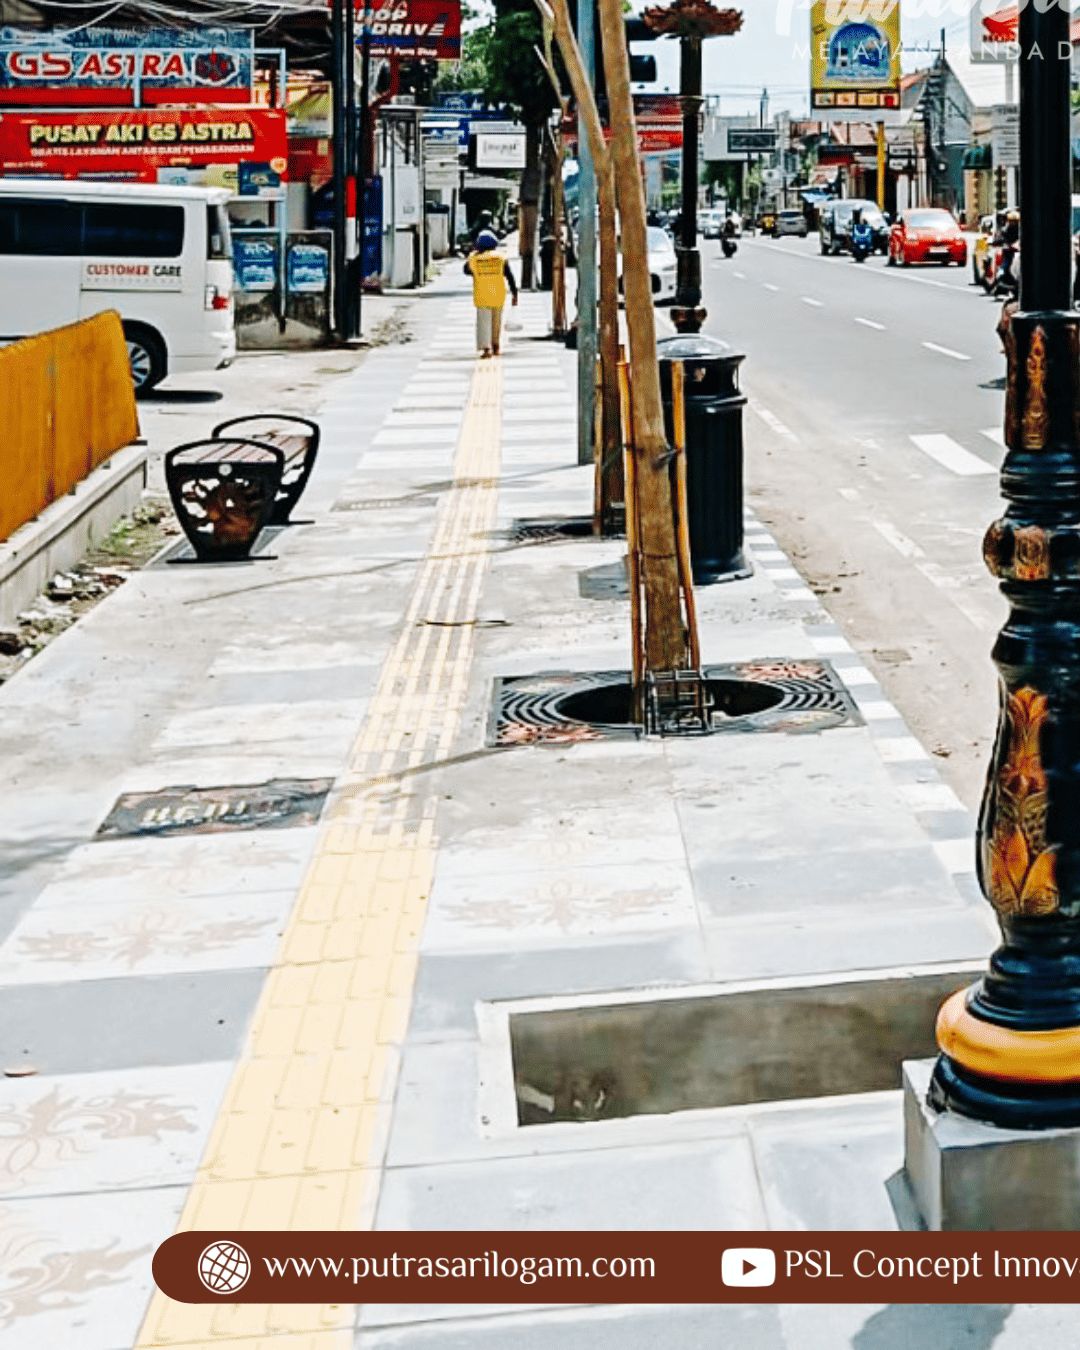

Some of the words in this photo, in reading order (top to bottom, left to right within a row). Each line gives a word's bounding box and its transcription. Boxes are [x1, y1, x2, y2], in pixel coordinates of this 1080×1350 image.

[7, 50, 72, 78] GS
[77, 51, 185, 78] ASTRA
[29, 124, 102, 143] PUSAT
[105, 123, 144, 142] AKI
[147, 122, 177, 141] GS
[180, 122, 253, 141] ASTRA
[86, 263, 150, 276] CUSTOMER
[153, 264, 182, 277] CARE
